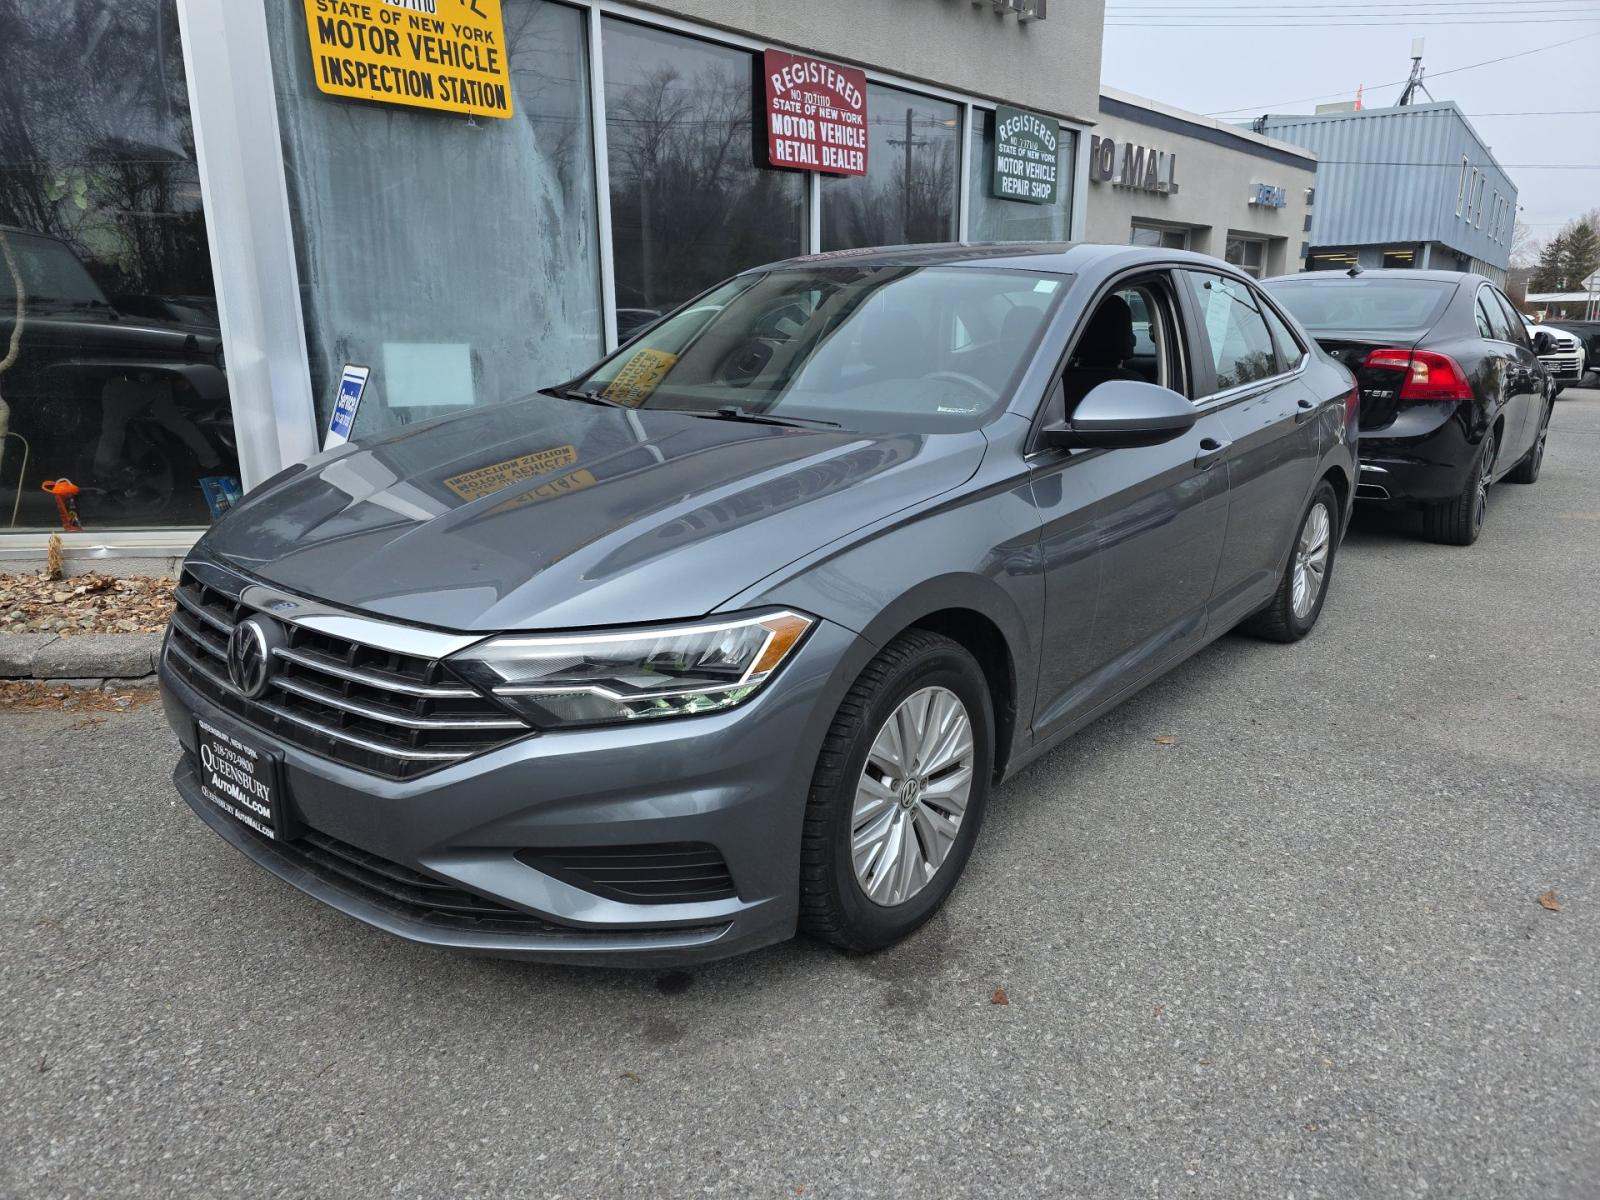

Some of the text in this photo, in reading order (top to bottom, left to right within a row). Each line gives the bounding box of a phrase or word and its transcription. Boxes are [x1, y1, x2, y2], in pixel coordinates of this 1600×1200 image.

[317, 0, 373, 20] STATE
[380, 9, 402, 26] OF
[408, 15, 445, 34] NEW
[451, 23, 495, 44] YORK
[316, 15, 501, 75] MOTOR VEHICLE
[320, 55, 507, 110] INSPECTION STATION
[771, 62, 862, 109] REGISTERED
[773, 98, 863, 125] STATE OF NEW YORK
[771, 112, 866, 149] MOTOR VEHICLE
[999, 115, 1056, 151] REGISTERED
[776, 138, 864, 171] RETAIL DEALER
[997, 156, 1056, 182] MOTOR VEHICLE
[998, 143, 1056, 163] STATE OF NEW YORK
[1002, 176, 1051, 199] REPAIR SHOP
[200, 744, 271, 802] QUEENSBURY
